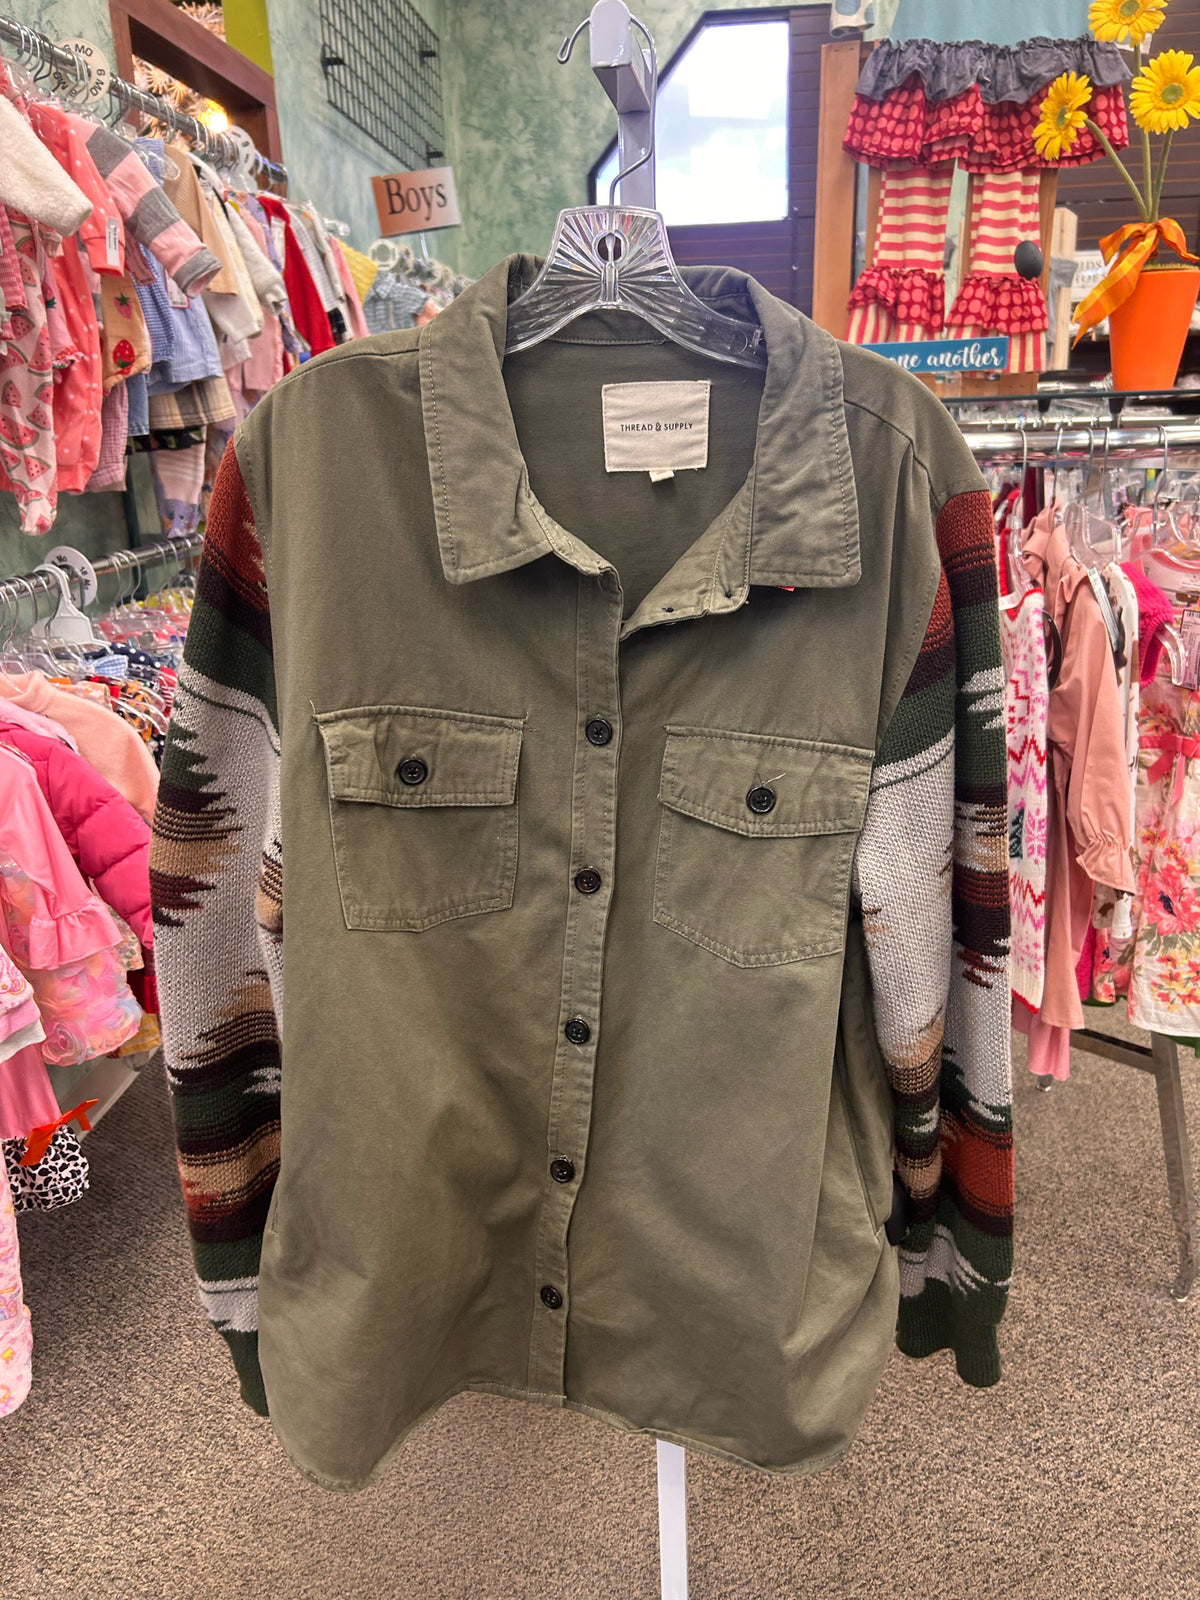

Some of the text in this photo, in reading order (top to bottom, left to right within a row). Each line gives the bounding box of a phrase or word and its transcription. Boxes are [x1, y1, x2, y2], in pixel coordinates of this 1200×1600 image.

[75, 44, 93, 56] MO
[383, 178, 448, 221] Boys
[926, 342, 1004, 368] another
[620, 422, 693, 432] THREAD & SUPPLY
